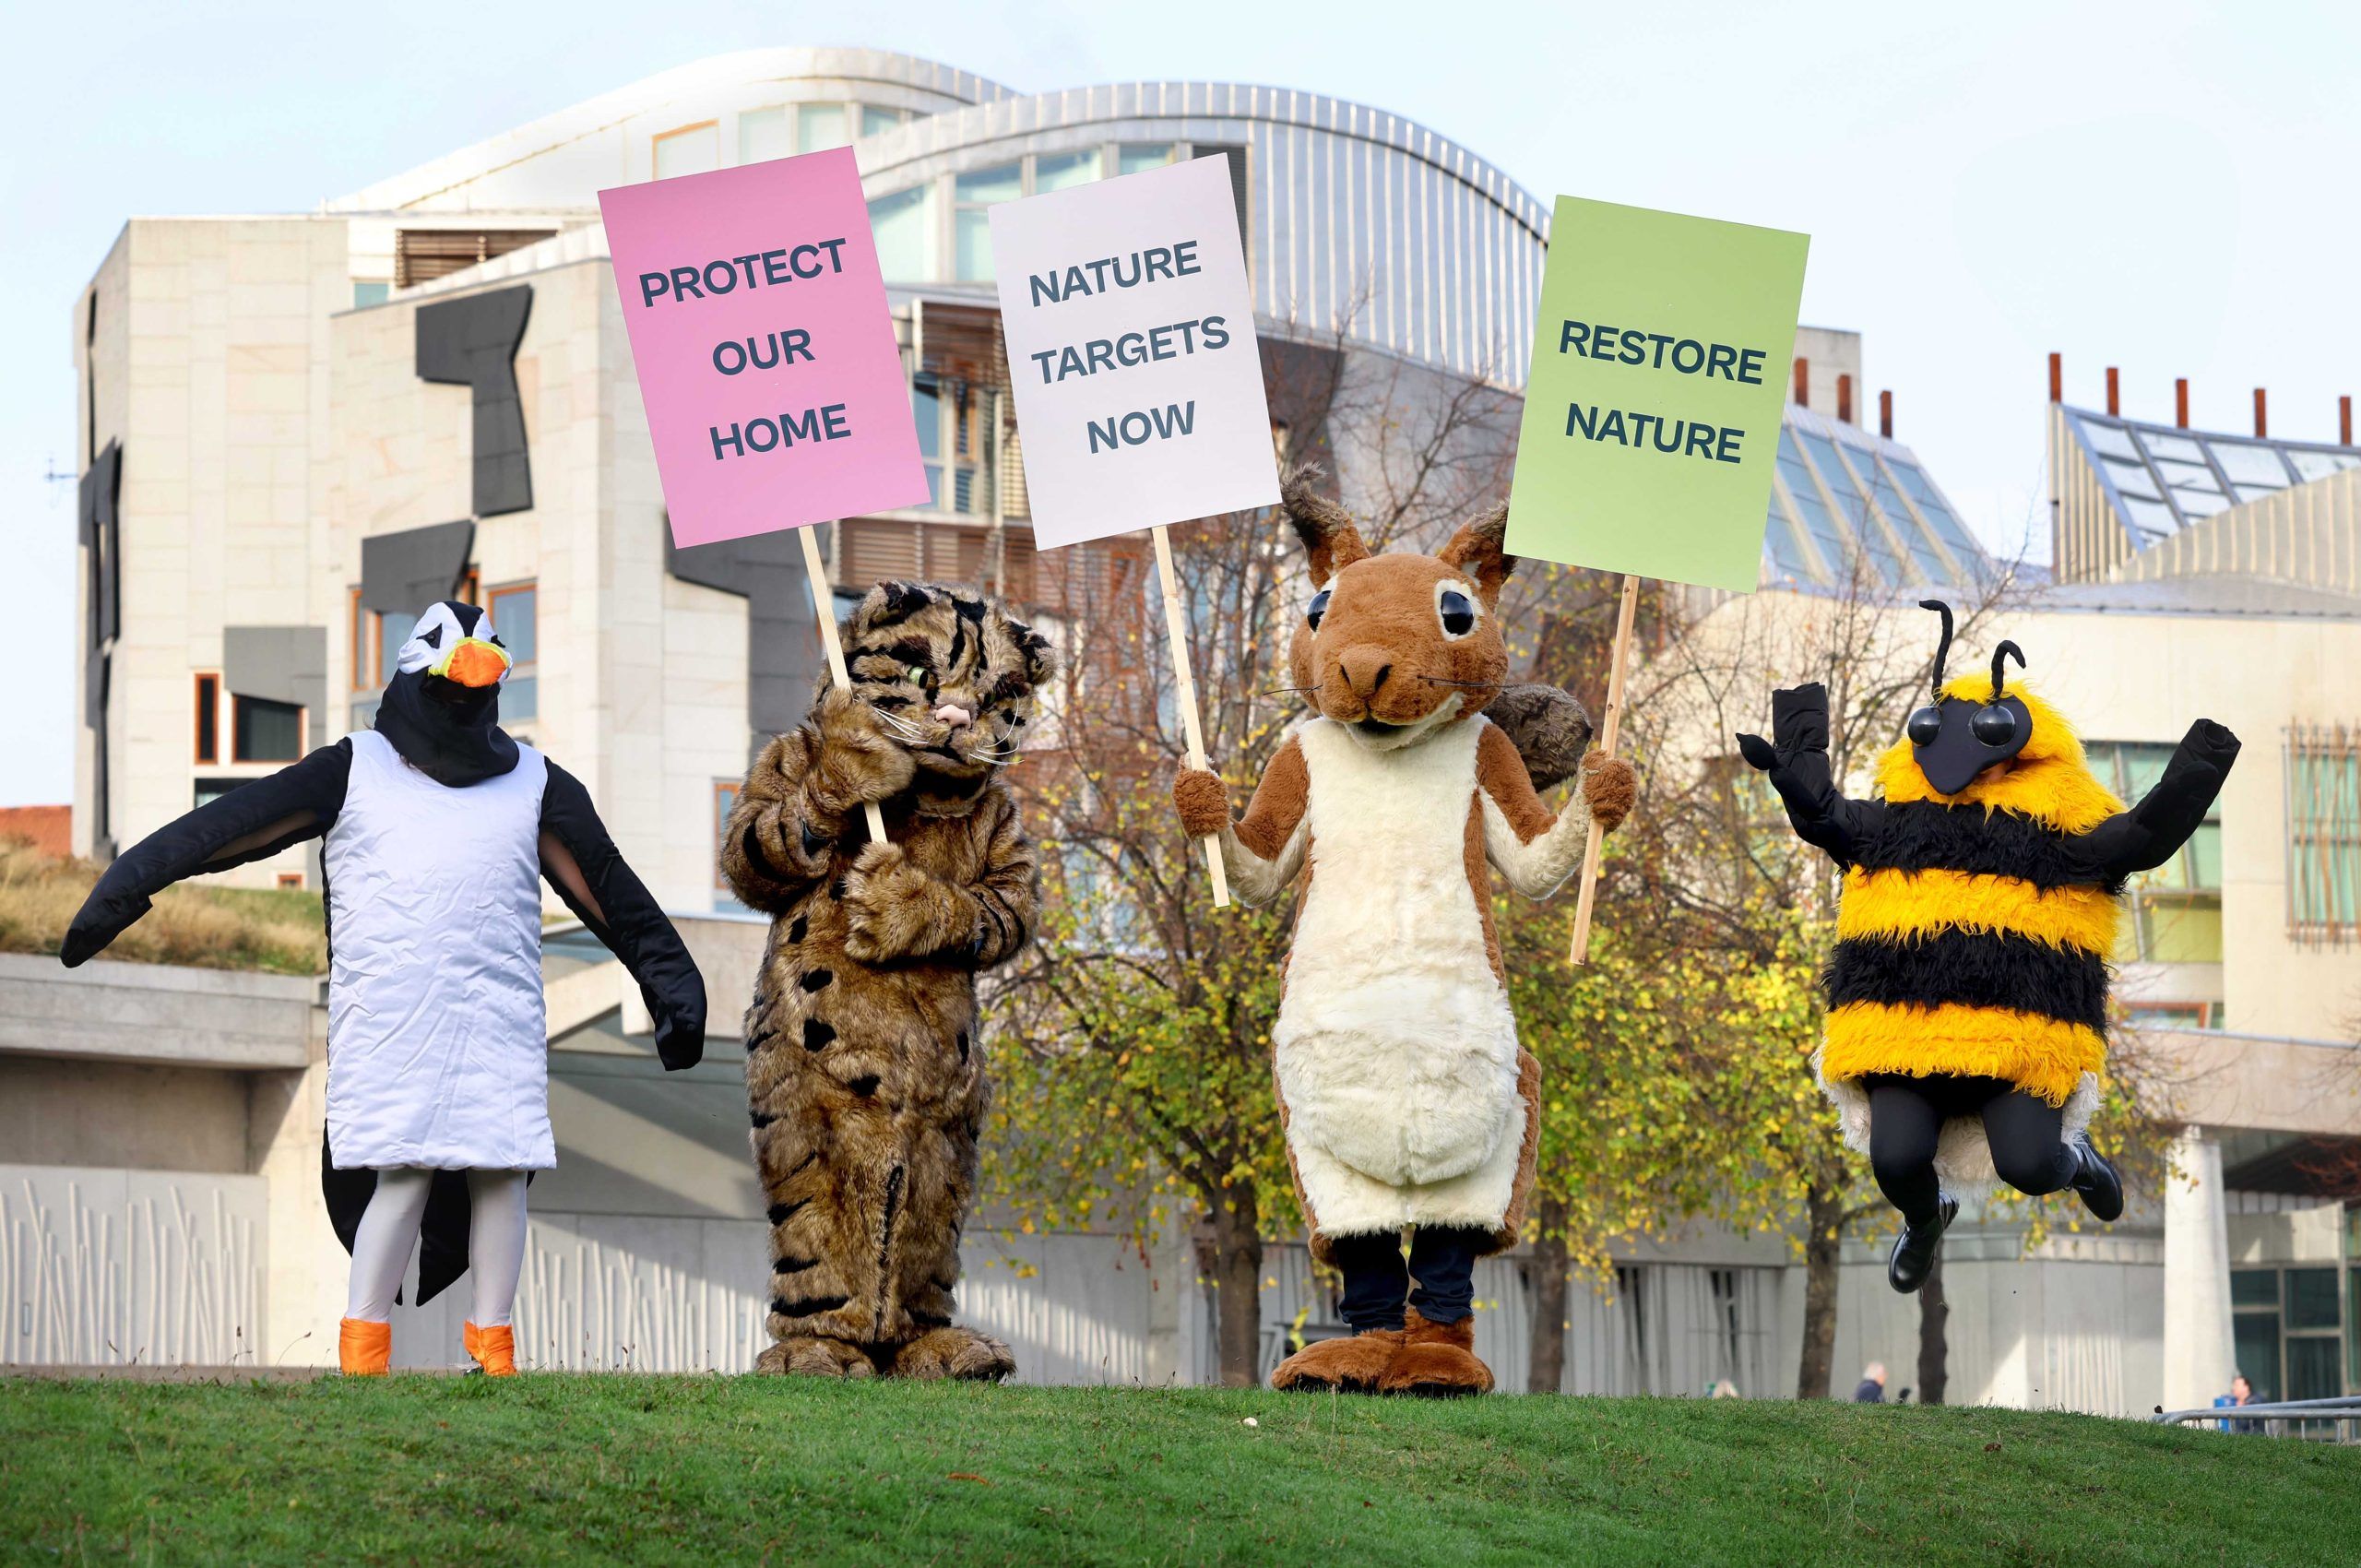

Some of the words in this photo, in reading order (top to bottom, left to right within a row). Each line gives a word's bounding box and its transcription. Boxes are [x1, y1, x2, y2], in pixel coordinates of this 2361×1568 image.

[639, 238, 846, 307] PROTECT
[1030, 241, 1201, 306] NATURE
[713, 329, 815, 375] OUR
[1031, 316, 1229, 384] TARGETS
[1560, 320, 1766, 385] RESTORE
[709, 403, 851, 460] HOME
[1087, 401, 1194, 453] NOW
[1566, 403, 1745, 463] NATURE
